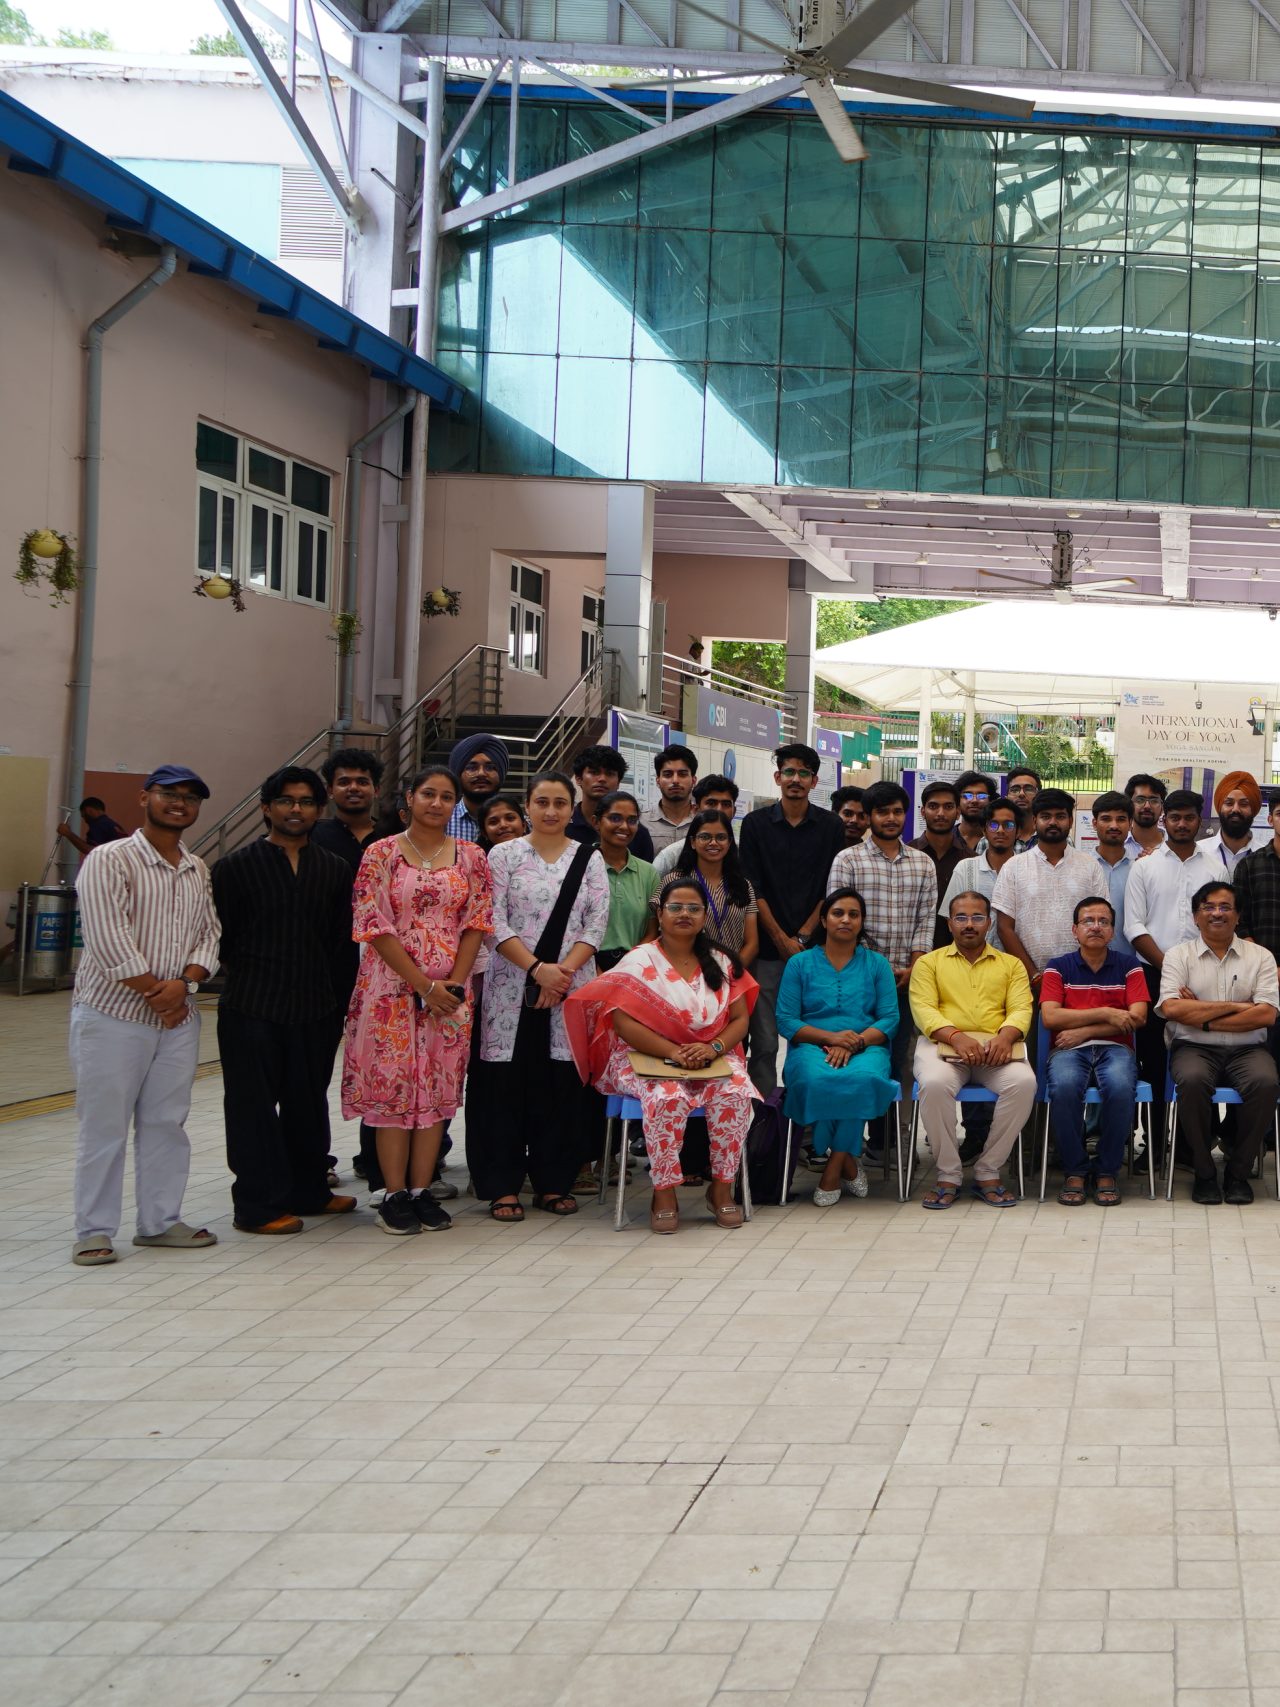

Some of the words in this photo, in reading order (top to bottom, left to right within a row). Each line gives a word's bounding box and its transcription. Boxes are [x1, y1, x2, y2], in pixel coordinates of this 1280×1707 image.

[715, 705, 727, 727] SBI
[1141, 714, 1243, 729] INTERNATIONAL
[1147, 729, 1172, 741] DAY
[1175, 730, 1195, 742] OF
[1199, 731, 1236, 744] YOGA
